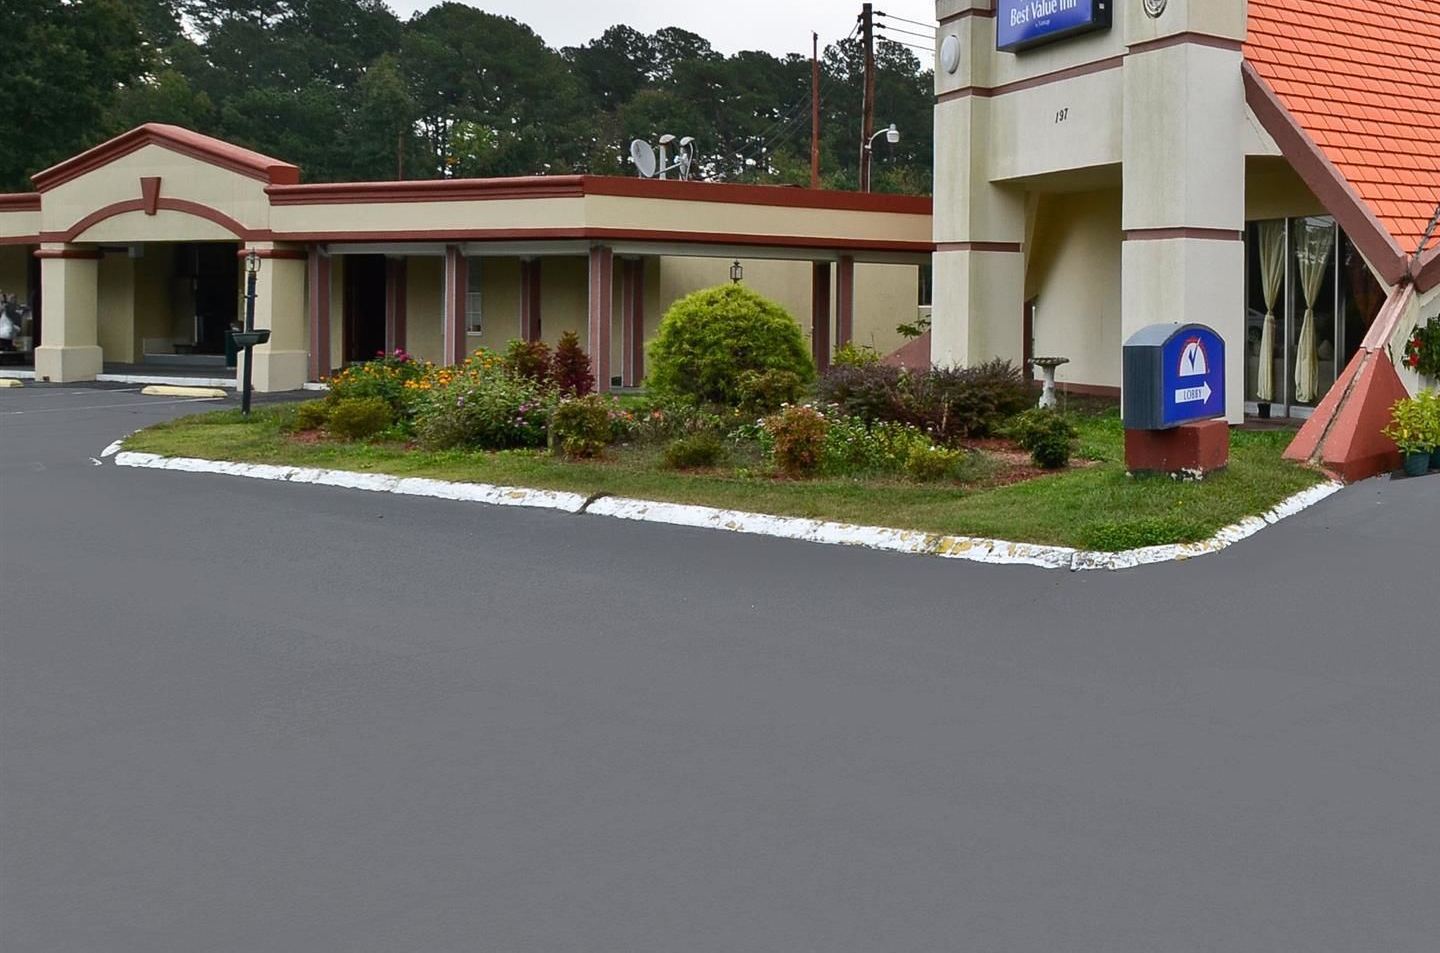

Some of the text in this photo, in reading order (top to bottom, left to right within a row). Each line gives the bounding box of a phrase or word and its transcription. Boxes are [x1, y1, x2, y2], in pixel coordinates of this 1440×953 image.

[1010, 3, 1029, 26] Best
[1055, 107, 1069, 124] 197
[1183, 389, 1202, 401] LOBBY
